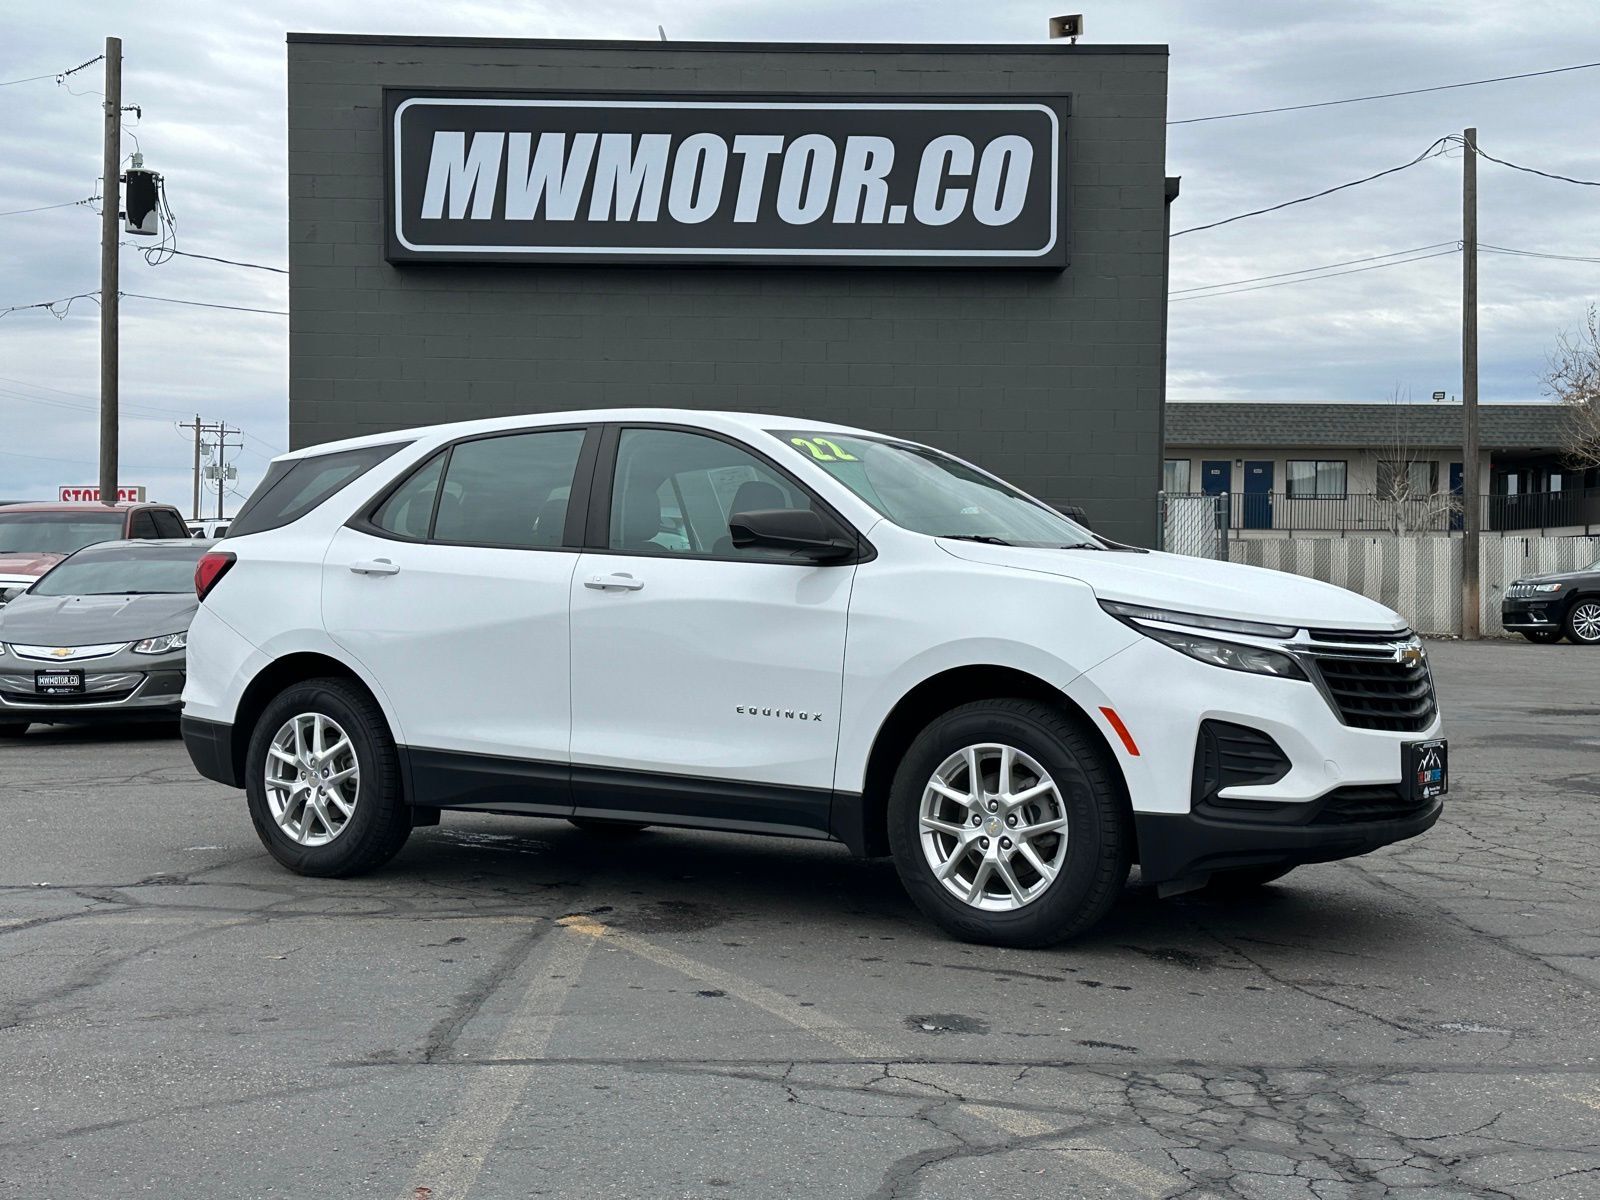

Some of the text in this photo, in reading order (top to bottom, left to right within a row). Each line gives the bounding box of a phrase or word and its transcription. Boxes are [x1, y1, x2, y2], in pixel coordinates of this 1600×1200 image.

[420, 131, 1034, 226] MWMOTOR.CO
[791, 438, 858, 460] 22
[62, 489, 137, 502] STOGE
[736, 705, 823, 721] EQUINOX
